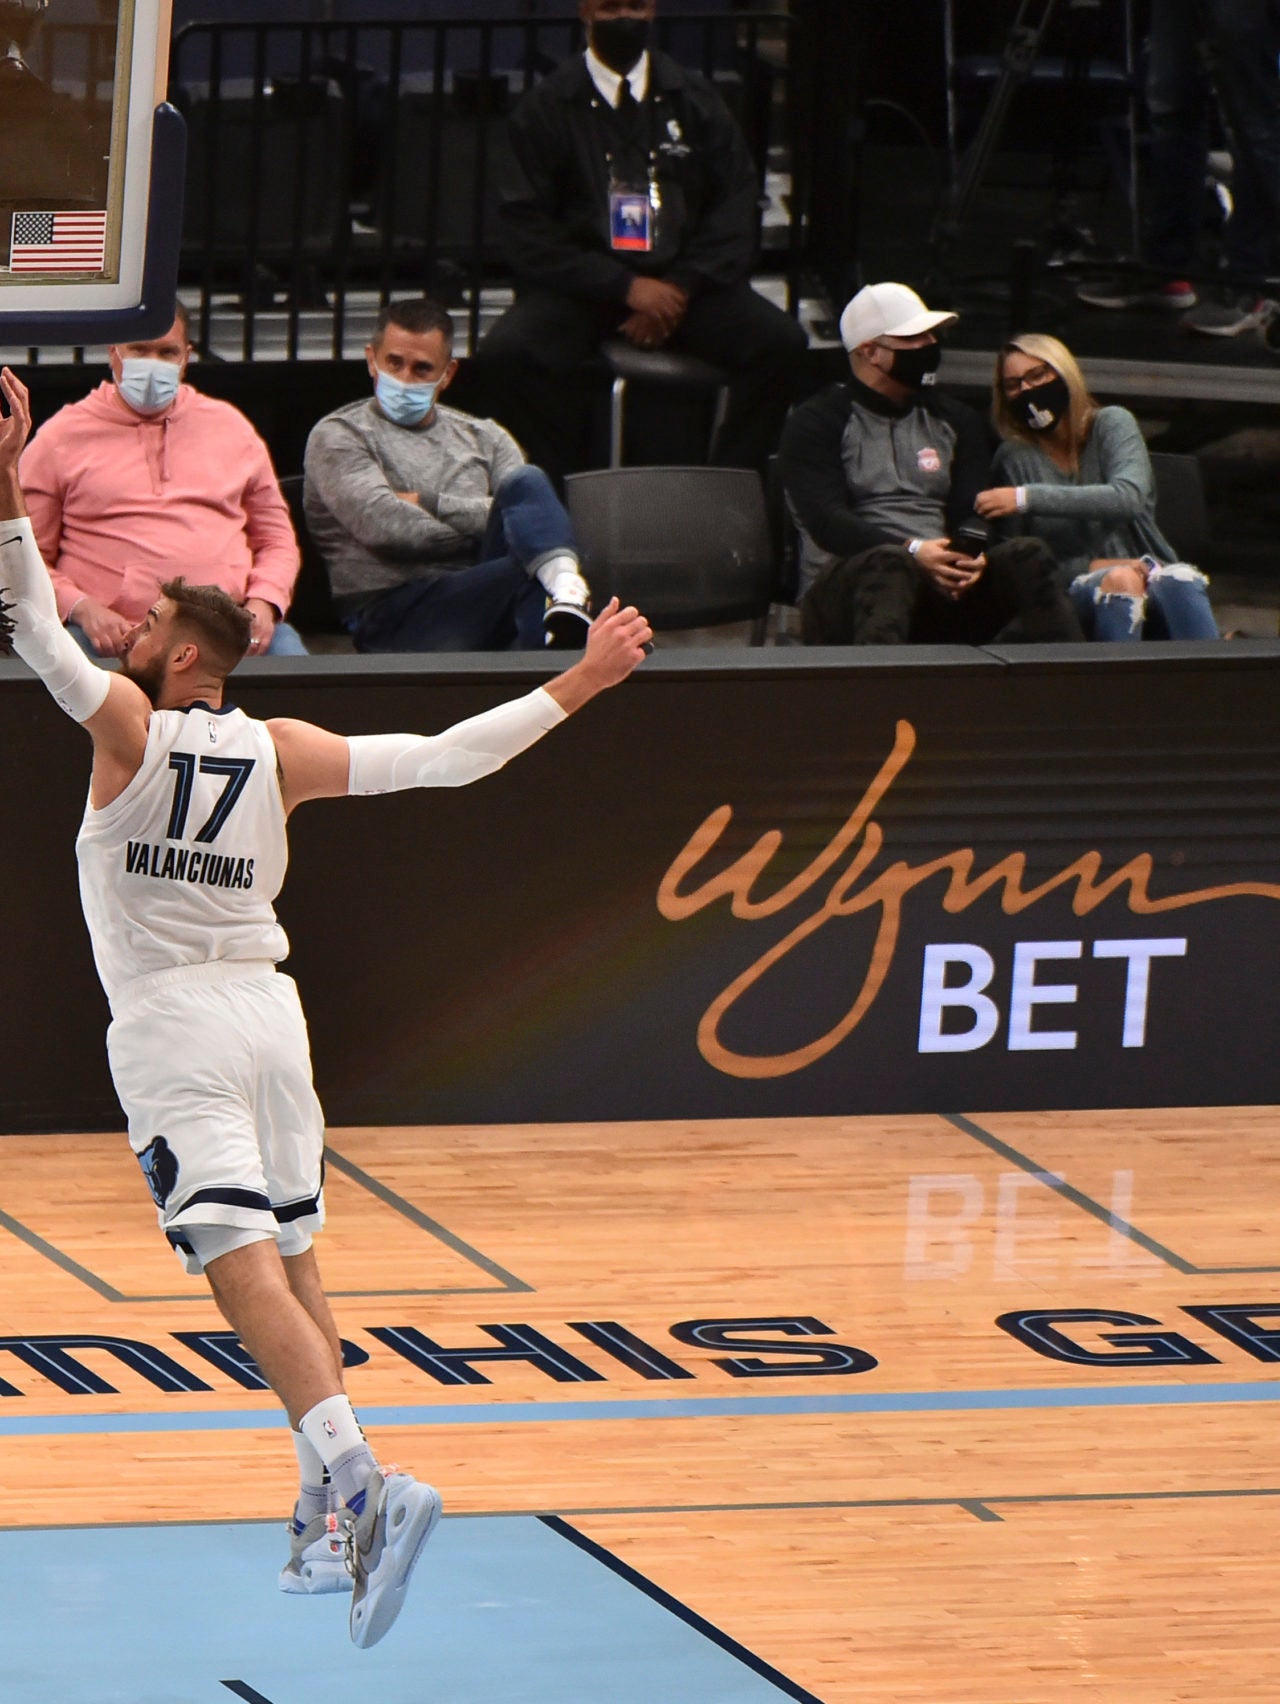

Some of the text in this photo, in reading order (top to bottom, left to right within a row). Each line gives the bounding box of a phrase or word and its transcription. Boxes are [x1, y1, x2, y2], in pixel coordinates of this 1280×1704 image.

[165, 751, 257, 844] 17
[125, 840, 255, 890] VALANCIUNAS
[918, 937, 1187, 1054] BET
